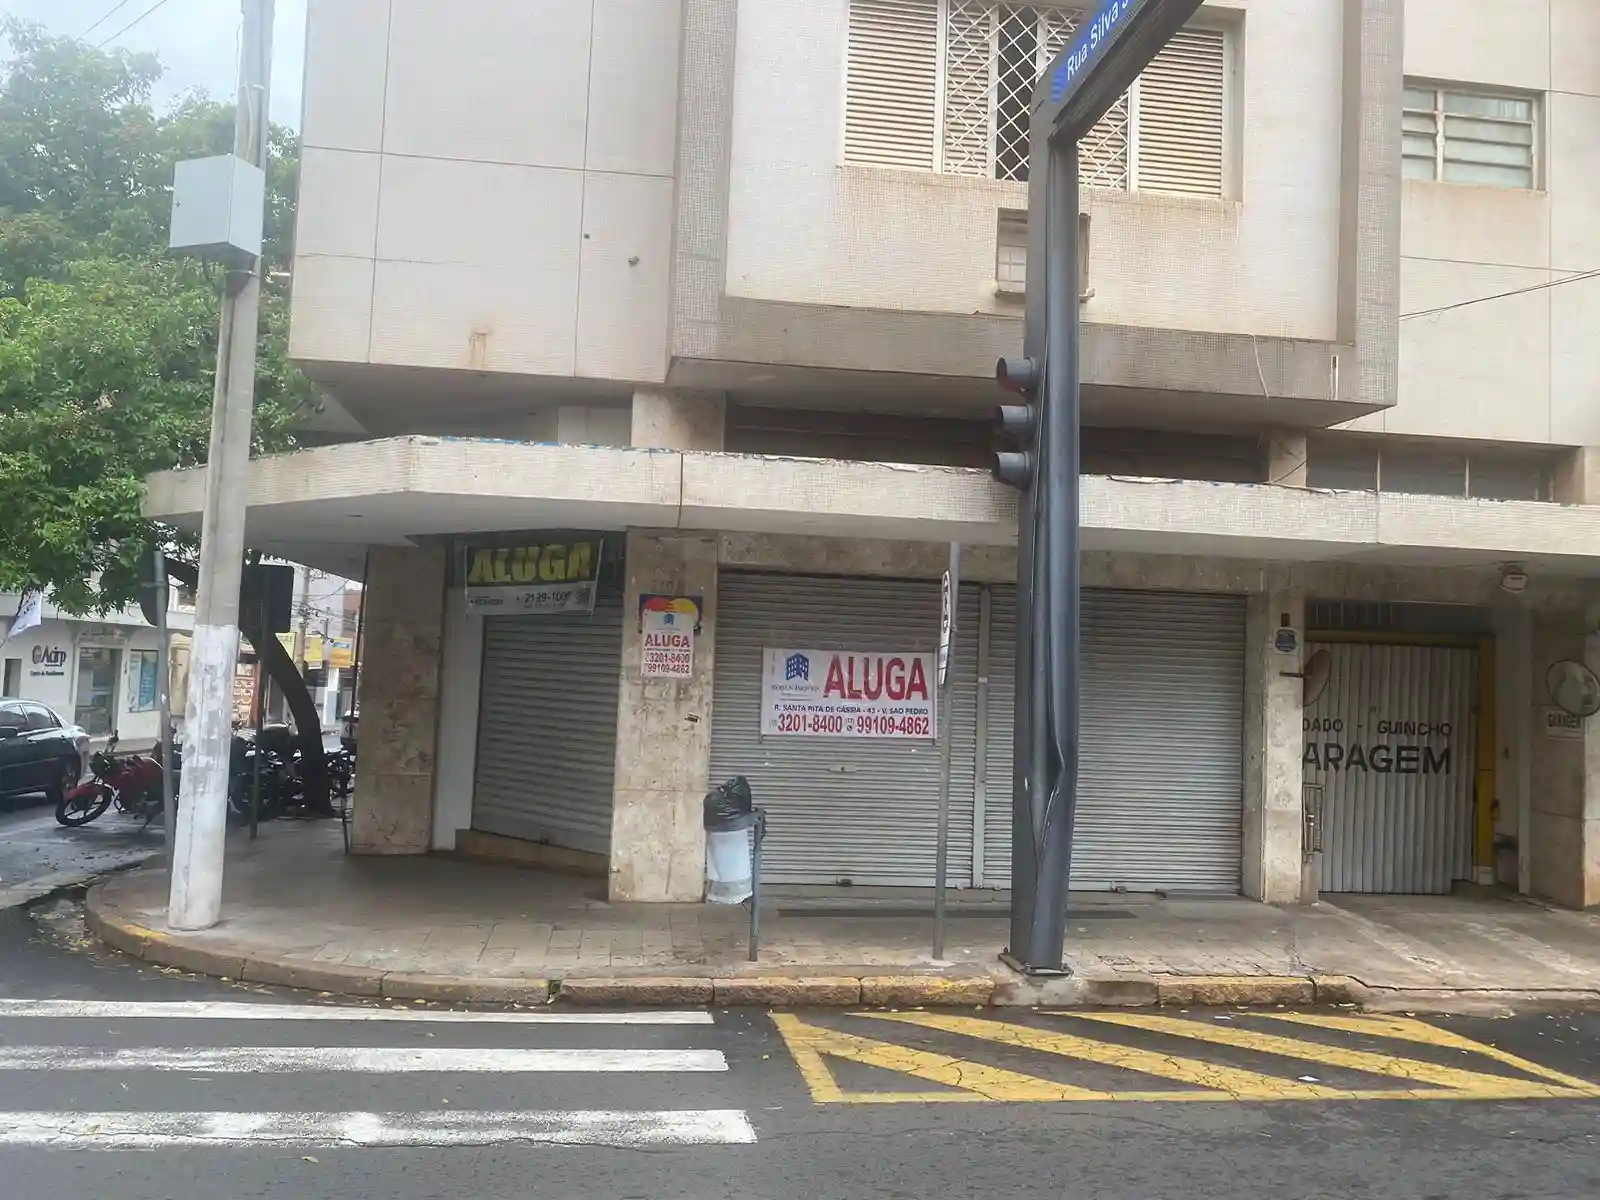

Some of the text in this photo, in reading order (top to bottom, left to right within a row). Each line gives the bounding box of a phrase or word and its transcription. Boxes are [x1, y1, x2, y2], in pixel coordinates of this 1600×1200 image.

[1067, 1, 1119, 80] Rua Silva
[468, 542, 591, 584] ALUGA
[644, 633, 691, 648] ALUGA
[823, 653, 929, 701] ALUGA
[783, 704, 806, 713] SANTA
[808, 705, 824, 713] RITA
[825, 705, 835, 714] DE
[905, 707, 929, 715] PEDRO
[777, 713, 843, 733] 3201-8400
[857, 715, 930, 735] 99109-4862
[1377, 719, 1453, 736] GUINCHO
[1302, 742, 1451, 775] ARAGEM
